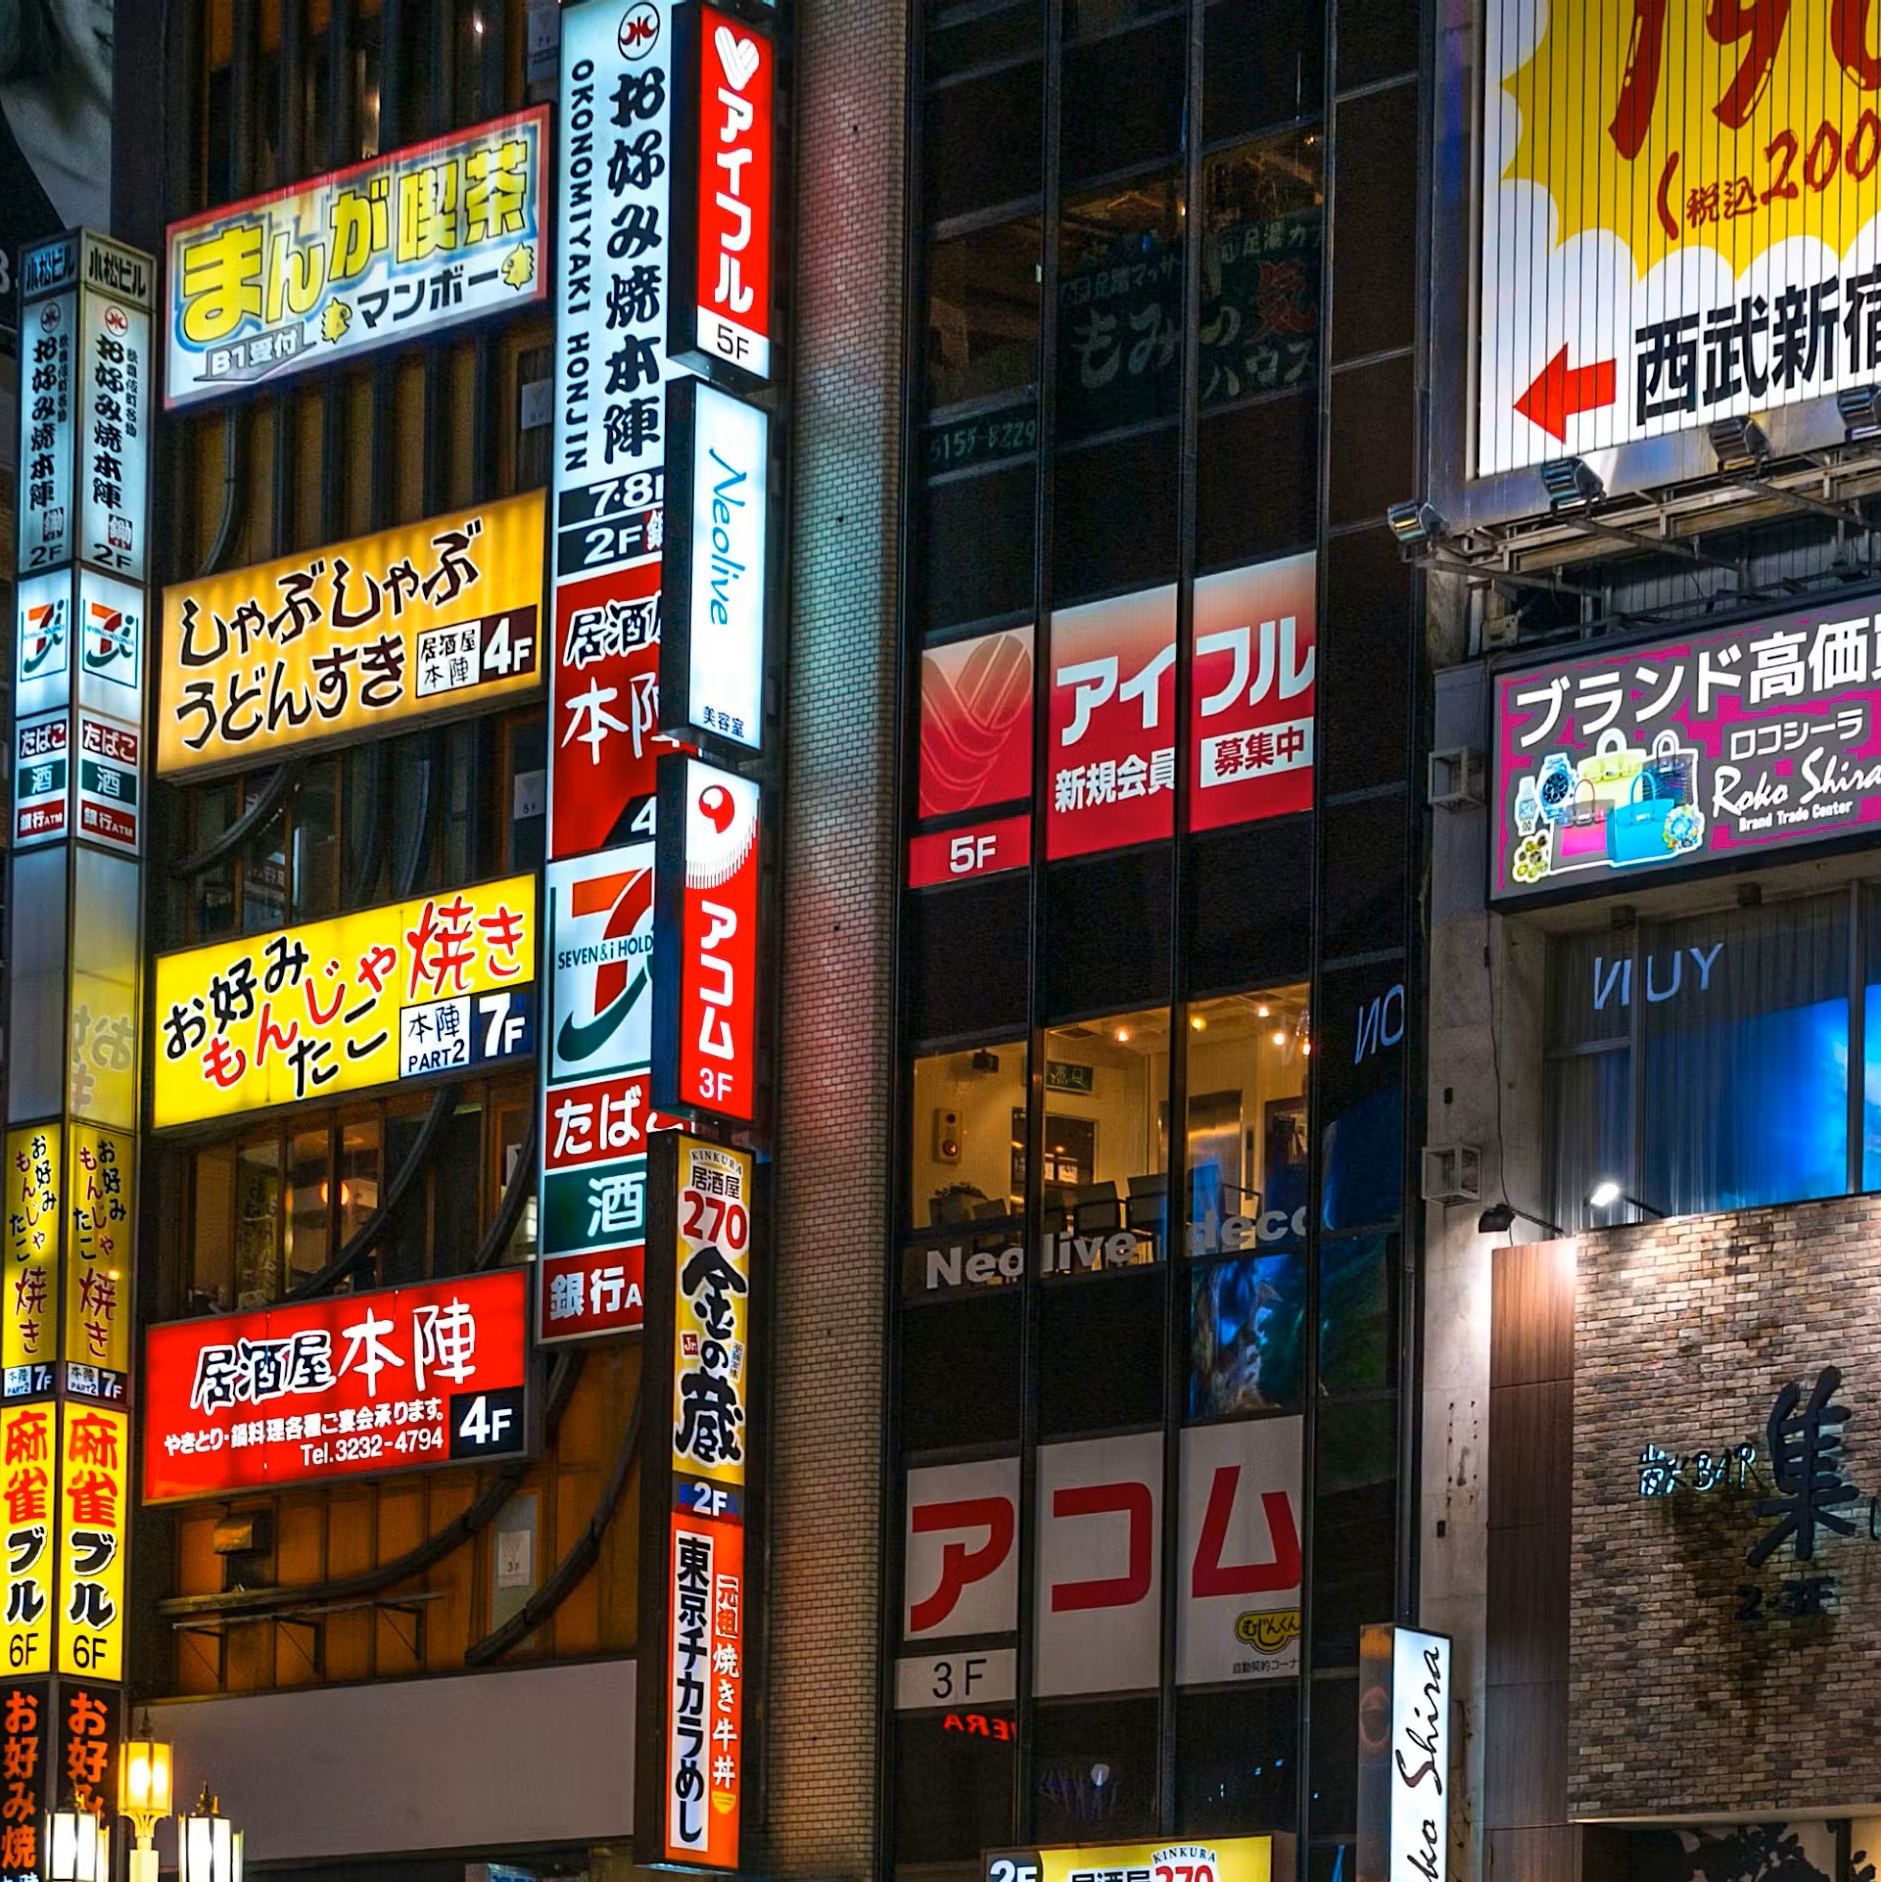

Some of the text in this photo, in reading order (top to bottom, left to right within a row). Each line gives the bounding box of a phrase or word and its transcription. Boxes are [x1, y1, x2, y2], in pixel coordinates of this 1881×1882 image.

[713, 86, 755, 316] アイフル
[26, 245, 75, 290] 小松ビル
[182, 138, 530, 342] まんが喫茶
[564, 60, 595, 472] OKONOMIYAKI HONJIN
[602, 64, 667, 466] お好み焼本陣
[88, 248, 147, 299] 小松ビル
[356, 256, 501, 332] マンボー
[716, 327, 751, 359] 5F
[30, 541, 64, 567] 2F
[709, 446, 748, 627] Neolive
[181, 518, 487, 667] しゃぶしゃぶ
[420, 627, 477, 663] 居酒屋
[423, 656, 470, 689] 本陣
[482, 620, 532, 675] 4F
[177, 634, 407, 750] うどんすき
[1054, 616, 1316, 748] アイフル
[20, 724, 65, 758] たばこ
[82, 725, 137, 763] たばこ
[702, 704, 746, 739] 美容室
[1729, 707, 1864, 763] ロコシーラ
[31, 766, 52, 797] 酒
[1054, 726, 1305, 814] 新規会員 募集中
[1710, 753, 1790, 818] Roko
[1738, 799, 1854, 833] Brand Trade Center
[949, 835, 997, 873] 5F
[409, 896, 527, 999] 焼き
[166, 936, 310, 1061] お好み
[698, 898, 738, 1061] アコム
[204, 943, 397, 1089] もんじゃ
[408, 1003, 460, 1039] 本陣
[479, 997, 525, 1058] 7F
[289, 996, 389, 1100] たこ
[407, 1039, 466, 1075] PART2
[699, 1070, 734, 1101] 3F
[587, 1175, 646, 1232] 酒
[683, 1190, 749, 1250] 270
[34, 1366, 53, 1392] 7F
[101, 1368, 124, 1397] 7F
[676, 1246, 750, 1466] 金の蔵
[300, 1428, 445, 1468] Tel.3232-4794
[458, 1397, 512, 1446] 4F
[1746, 1365, 1861, 1567] 集
[6, 1409, 47, 1623] 麻雀ブル
[67, 1411, 118, 1626] 麻雀ブル
[692, 1488, 728, 1516] 2F
[910, 1465, 1302, 1633] アコム
[10, 1631, 37, 1668] 6F
[73, 1634, 107, 1669] 6F
[674, 1535, 710, 1843] 東京チカラめし
[932, 1658, 988, 1701] 3F
[0, 1689, 40, 1870] お好み焼
[1151, 1846, 1218, 1866] KINKURA
